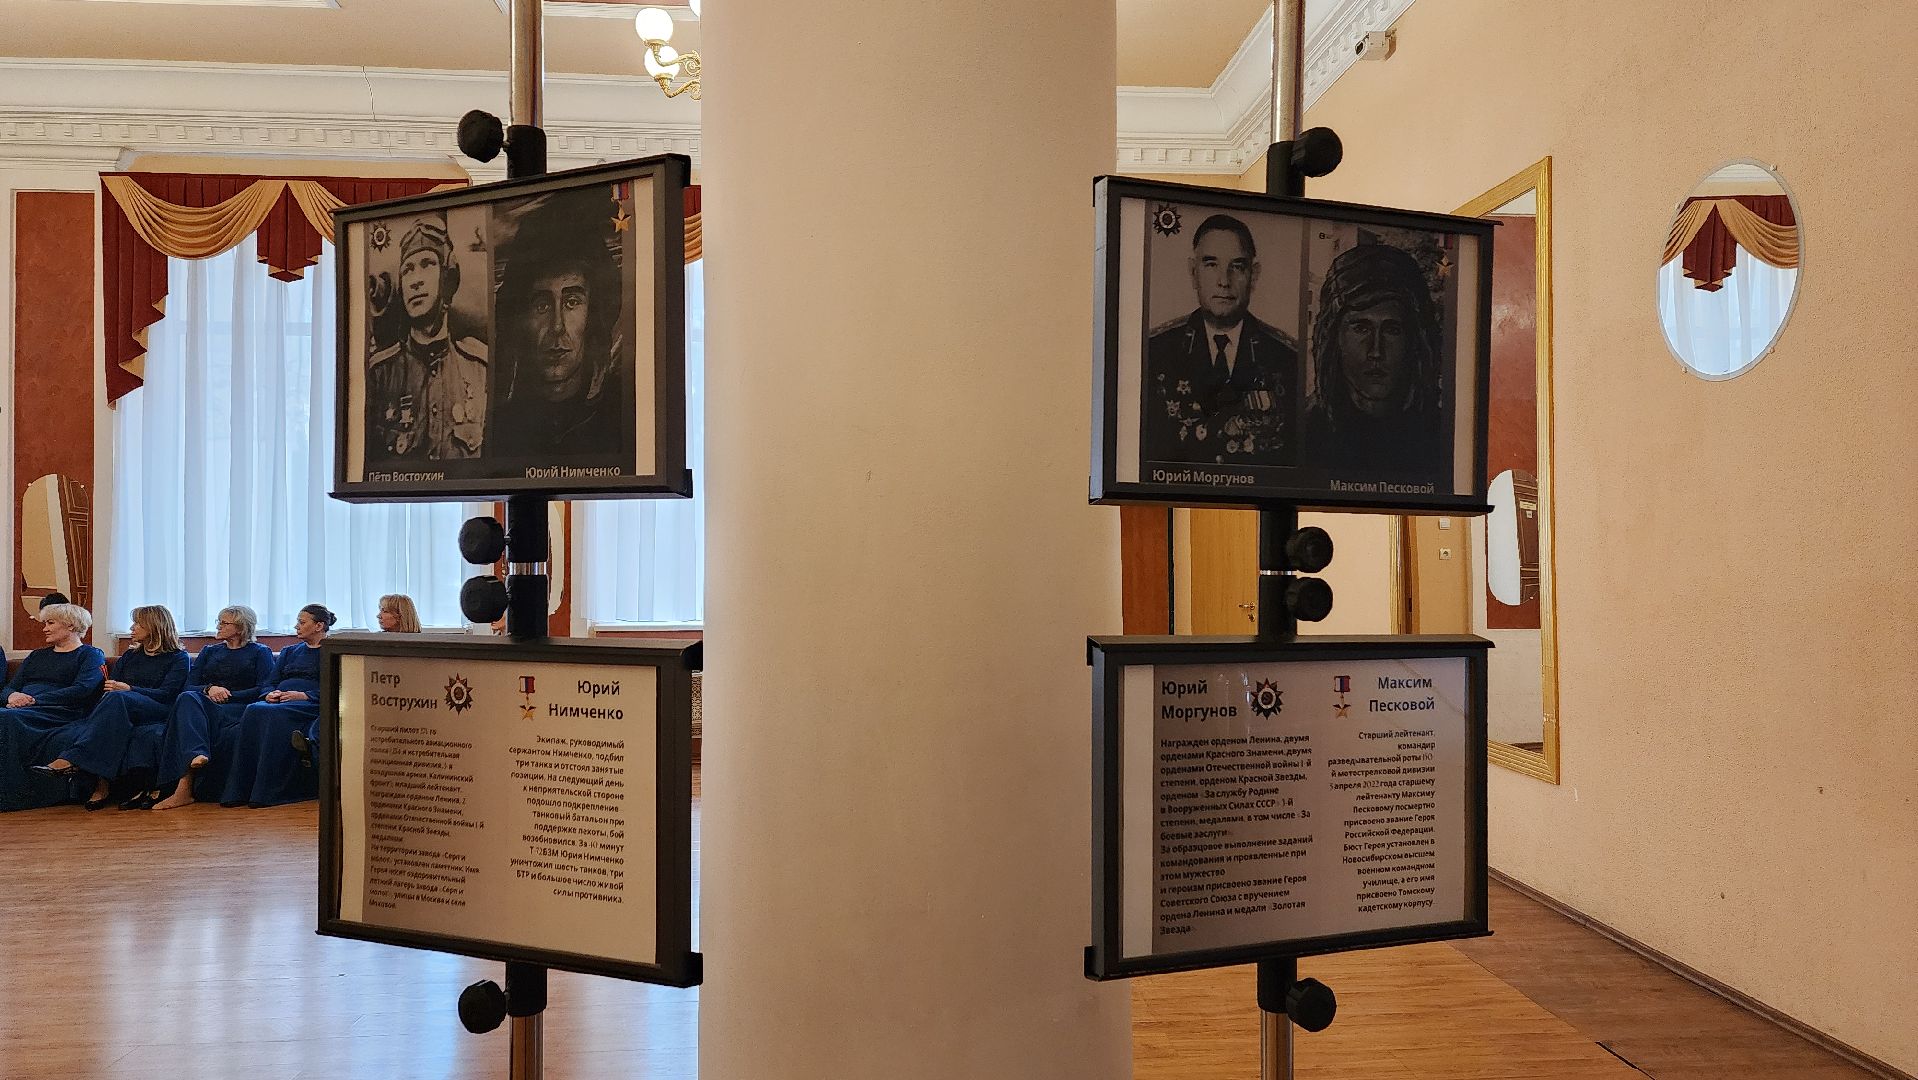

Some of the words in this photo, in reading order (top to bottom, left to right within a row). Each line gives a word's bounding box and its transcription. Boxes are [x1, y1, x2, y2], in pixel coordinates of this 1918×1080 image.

[526, 466, 558, 478] Юрий
[561, 466, 620, 477] Нимченко
[1153, 470, 1190, 484] Юрий
[1194, 471, 1254, 486] Моргунов
[1330, 480, 1377, 492] Максим
[1380, 482, 1434, 493] Песковой
[371, 671, 400, 687] Петр
[1378, 677, 1432, 689] Максим
[578, 680, 620, 698] Юрий
[1162, 680, 1208, 698] Юрий
[371, 694, 437, 711] Вострухин
[1369, 697, 1435, 712] Песковой
[549, 703, 623, 720] Нимченко
[1162, 706, 1237, 722] Моргунов
[1211, 738, 1248, 746] орденом
[1284, 735, 1309, 745] двумя
[1359, 730, 1393, 740] Старший
[509, 747, 551, 756] сержантом
[1398, 742, 1435, 750] командир
[1161, 751, 1204, 762] орденами
[1206, 749, 1245, 761] Красного
[1328, 754, 1401, 767] разведывательной
[1403, 755, 1421, 763] роты
[516, 760, 529, 768] три
[1161, 765, 1204, 775] орденами
[1206, 761, 1271, 772] Отечественной
[1338, 767, 1400, 777] мотострелковой
[1402, 766, 1435, 774] дивизии
[605, 780, 624, 788] день
[1200, 776, 1237, 786] орденом
[1238, 772, 1274, 784] Красной
[1380, 780, 1397, 788] года
[1398, 778, 1435, 787] старшему
[528, 785, 591, 798] неприятельской
[594, 791, 624, 800] стороне
[1402, 790, 1435, 798] Максиму
[527, 797, 561, 807] подошло
[1353, 805, 1394, 813] Песковому
[1395, 802, 1435, 811] посмертно
[533, 811, 570, 821] танковый
[572, 813, 608, 824] батальон
[610, 818, 624, 827] при
[1415, 814, 1435, 822] Героя
[534, 823, 576, 834] поддержке
[610, 830, 624, 839] бой
[1345, 828, 1390, 839] Российской
[600, 843, 624, 853] минут
[1344, 843, 1362, 852] Бюст
[1364, 842, 1385, 851] Героя
[1386, 840, 1429, 850] установлен
[584, 853, 624, 865] Нимченко
[1291, 849, 1307, 858] при
[1343, 852, 1403, 864] Новосибирском
[510, 858, 553, 869] уничтожил
[610, 869, 623, 879] три
[516, 870, 529, 878] БТР
[1357, 866, 1390, 875] военном
[1392, 862, 1435, 872] командном
[553, 889, 573, 897] силы
[1399, 887, 1435, 896] Томскому
[1358, 902, 1402, 912] кадетскому
